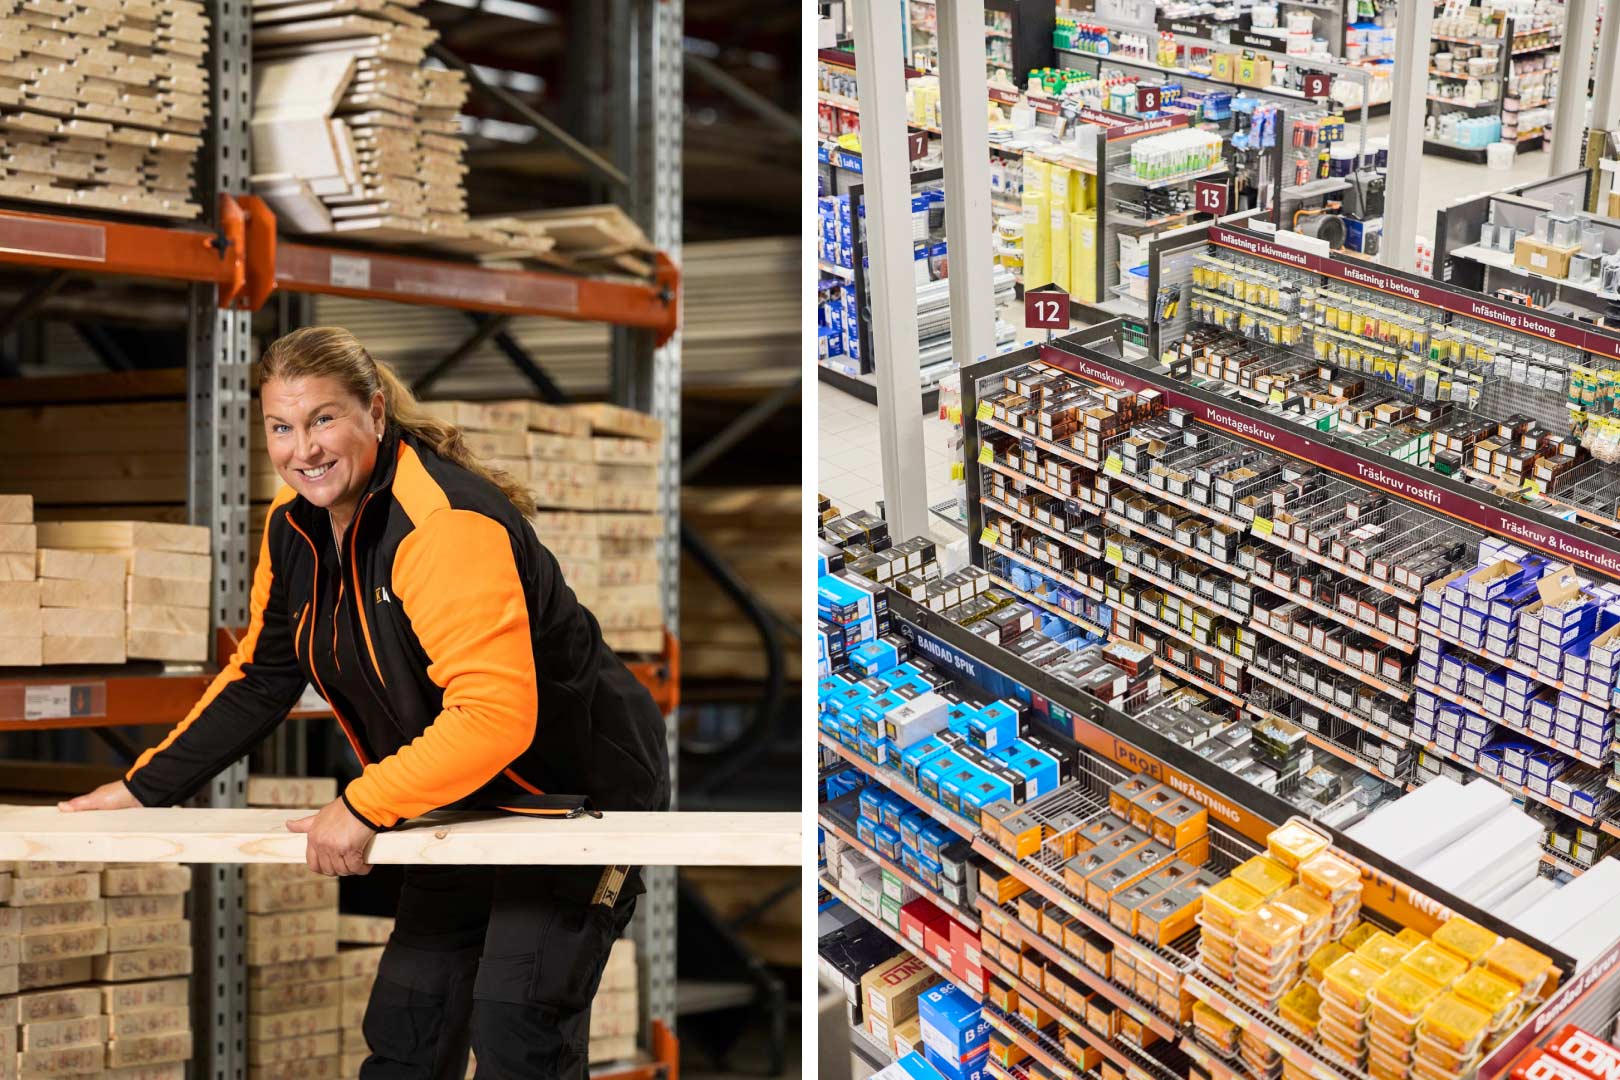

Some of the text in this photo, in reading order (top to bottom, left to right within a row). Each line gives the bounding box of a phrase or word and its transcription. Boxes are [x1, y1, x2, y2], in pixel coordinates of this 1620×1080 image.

[1145, 92, 1155, 107] 8
[1312, 79, 1322, 94] 9
[1202, 189, 1220, 208] 13
[1220, 233, 1307, 264] Infästning i skivmaterial
[1344, 267, 1419, 298] Infästning i betong
[1034, 300, 1060, 322] 12
[1472, 303, 1556, 337] Infästning i betong
[1079, 361, 1125, 387] Karmskruv
[1206, 407, 1275, 442] Montageskruv
[1356, 462, 1441, 504] Träskruv rostfri
[1500, 517, 1546, 543] Träskruv
[1548, 535, 1557, 548] &
[917, 635, 976, 677] BANDAD SPIK
[1170, 775, 1240, 823] INFÄSTNING
[928, 991, 942, 1002] B
[965, 1028, 976, 1043] B
